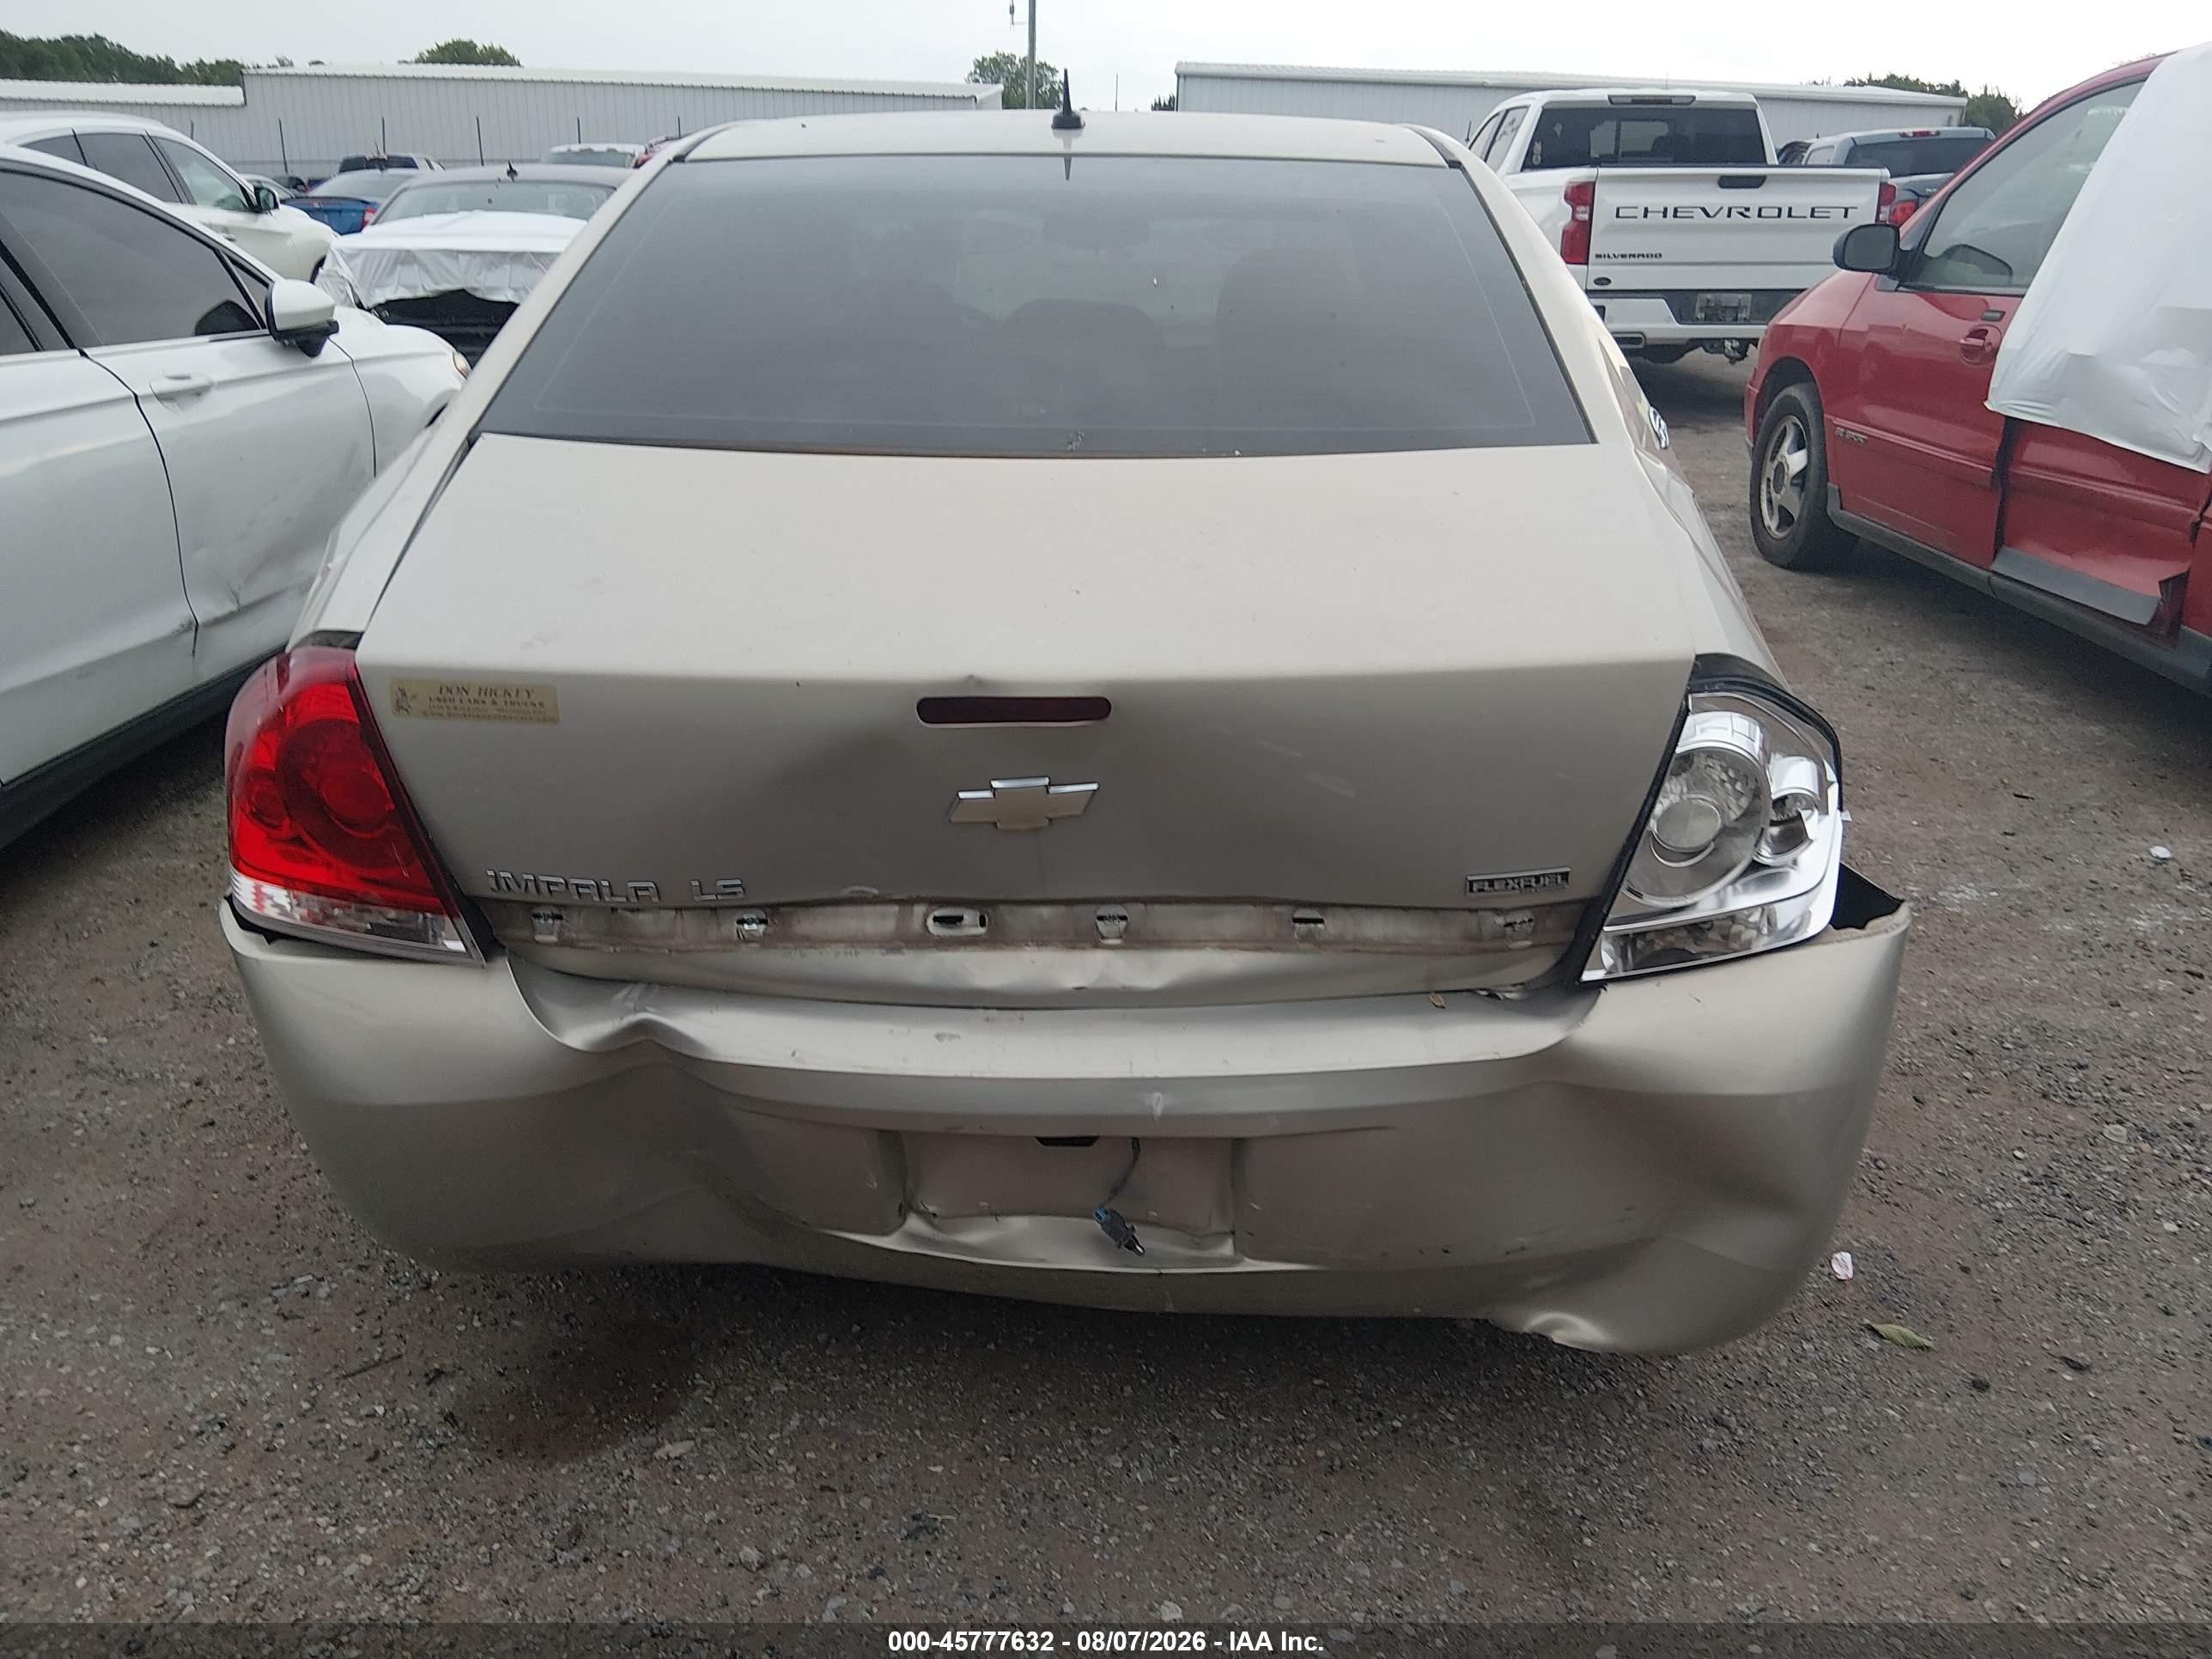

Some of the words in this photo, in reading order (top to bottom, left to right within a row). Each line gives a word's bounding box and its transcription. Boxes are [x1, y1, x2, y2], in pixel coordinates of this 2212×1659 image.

[1615, 206, 1858, 219] CHEVROLET
[486, 868, 660, 902] IMPALA
[690, 878, 745, 901] LS
